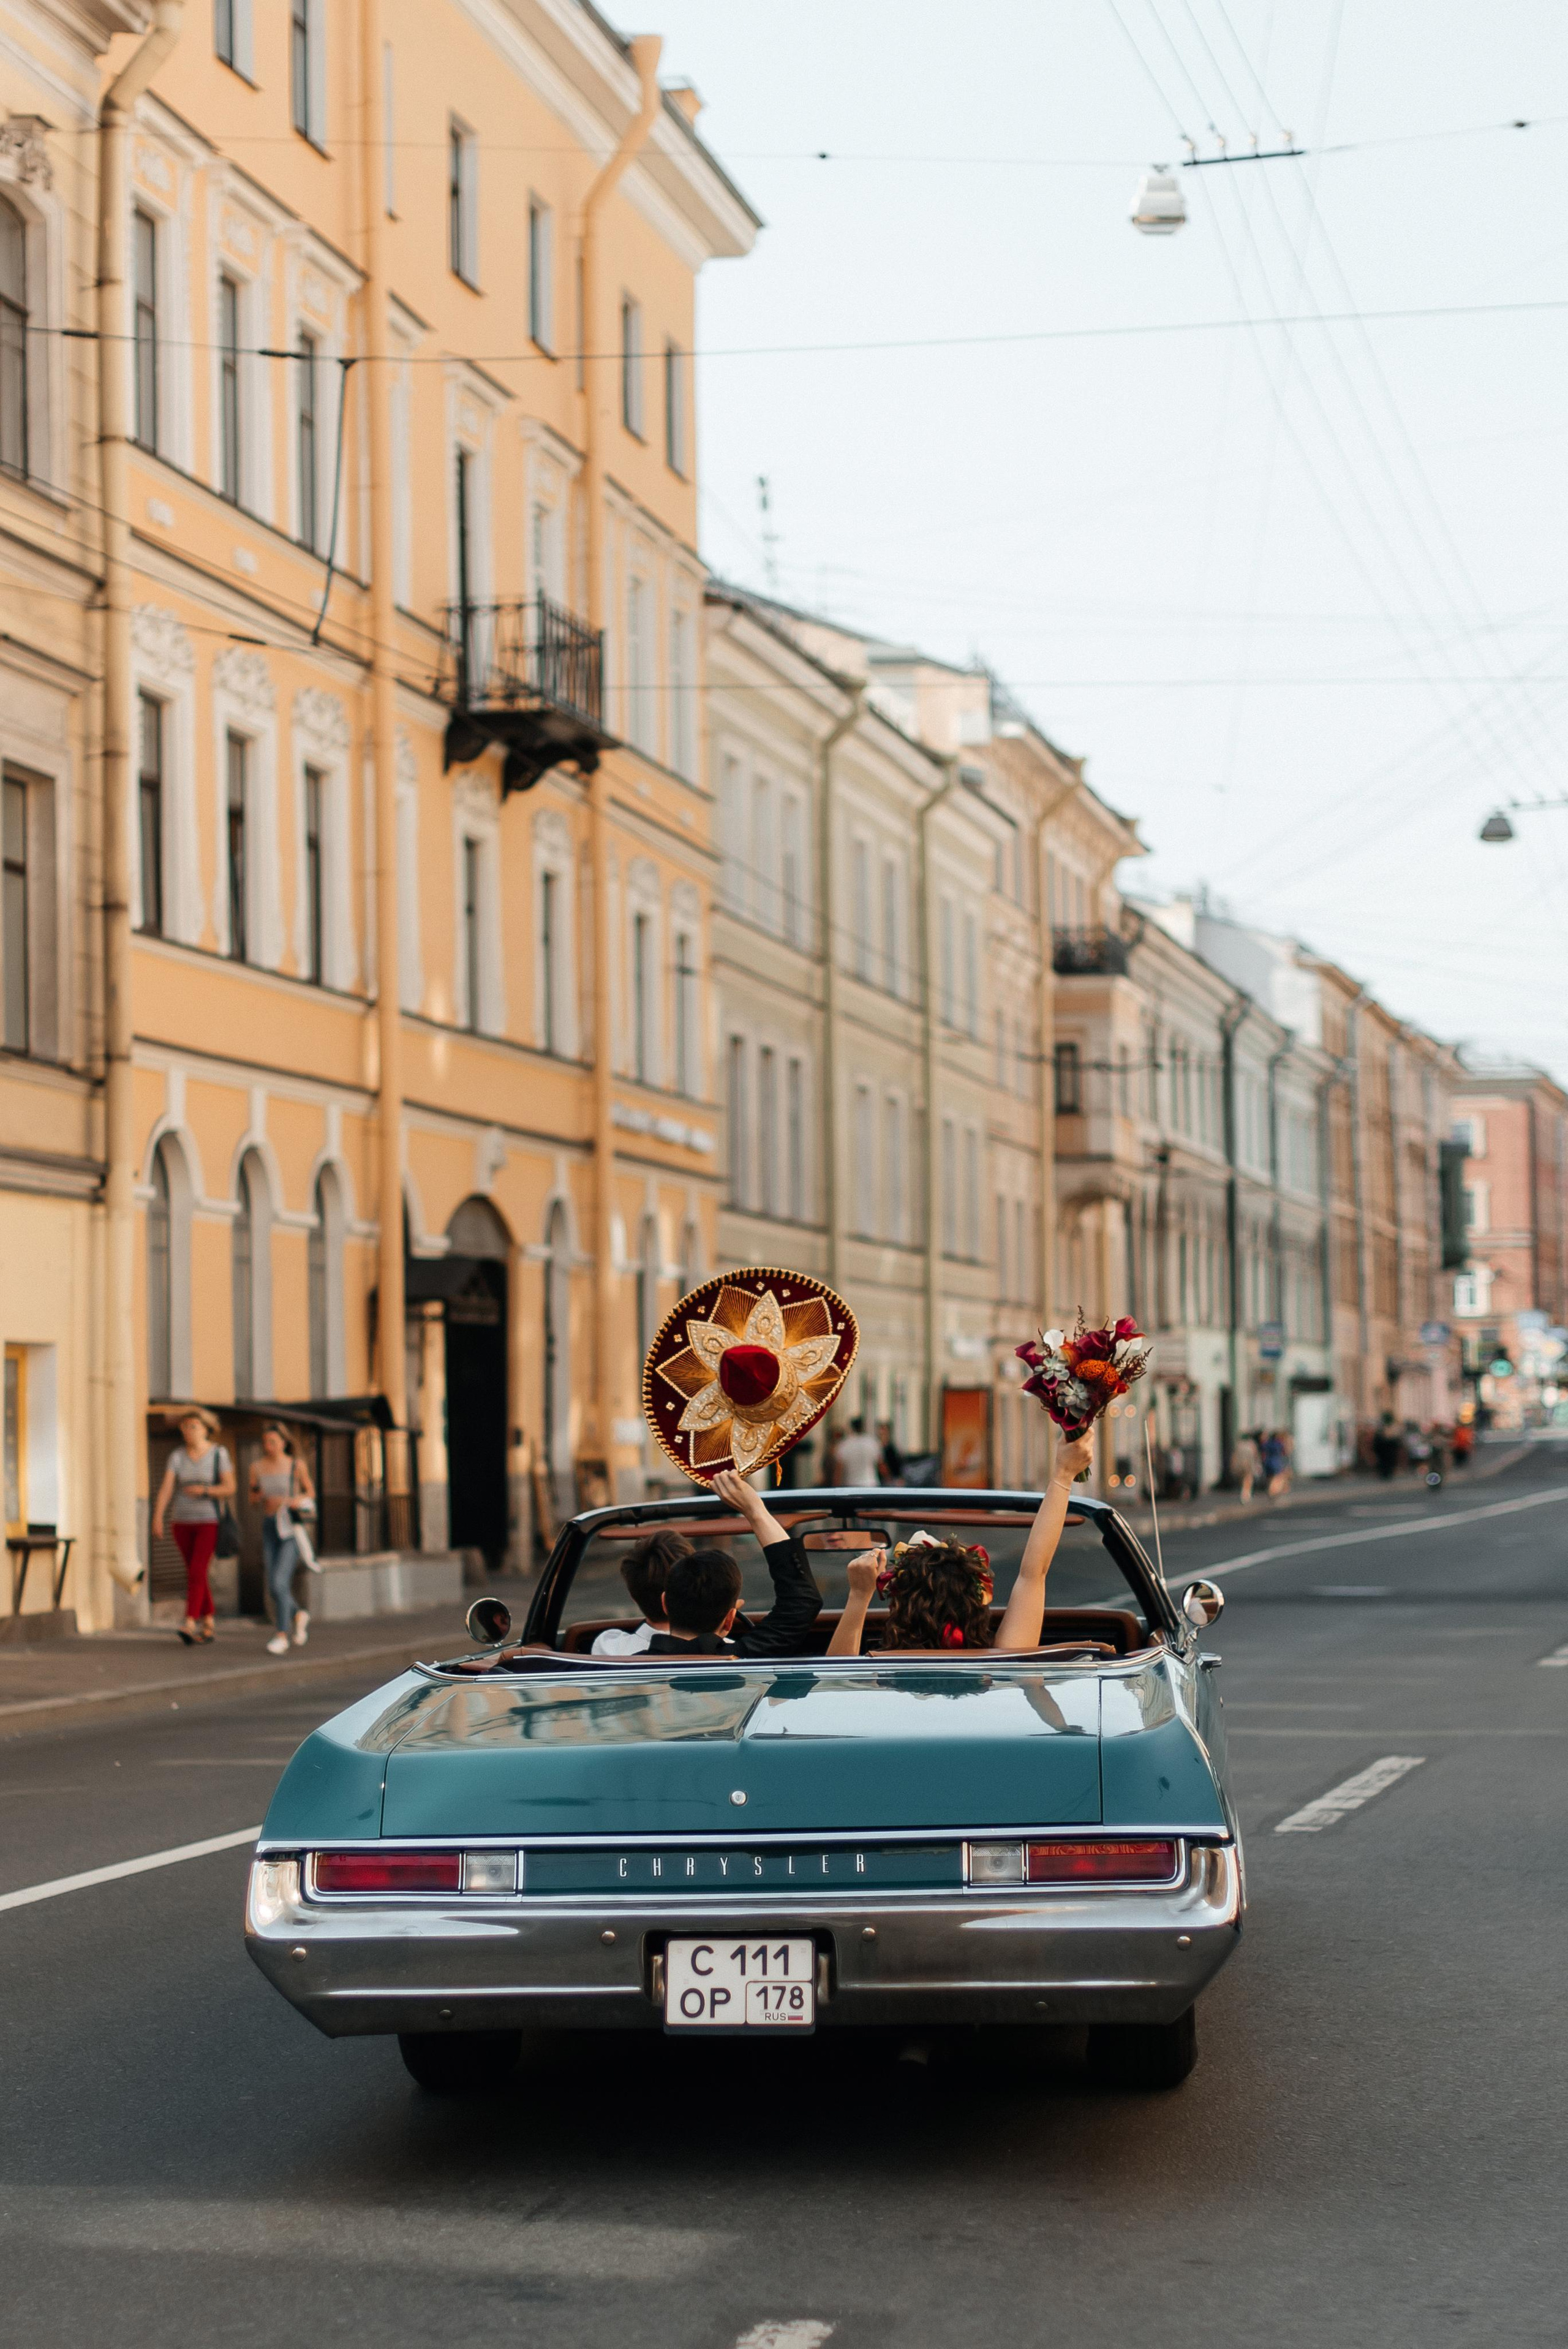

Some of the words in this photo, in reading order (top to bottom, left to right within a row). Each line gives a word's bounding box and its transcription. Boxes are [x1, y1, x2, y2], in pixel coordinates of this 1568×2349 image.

[619, 1854, 864, 1877] CHRYSLER
[730, 1945, 789, 1976] 111
[680, 1988, 731, 2018] OP
[756, 1986, 804, 2010] 178
[765, 2012, 786, 2021] RUS
